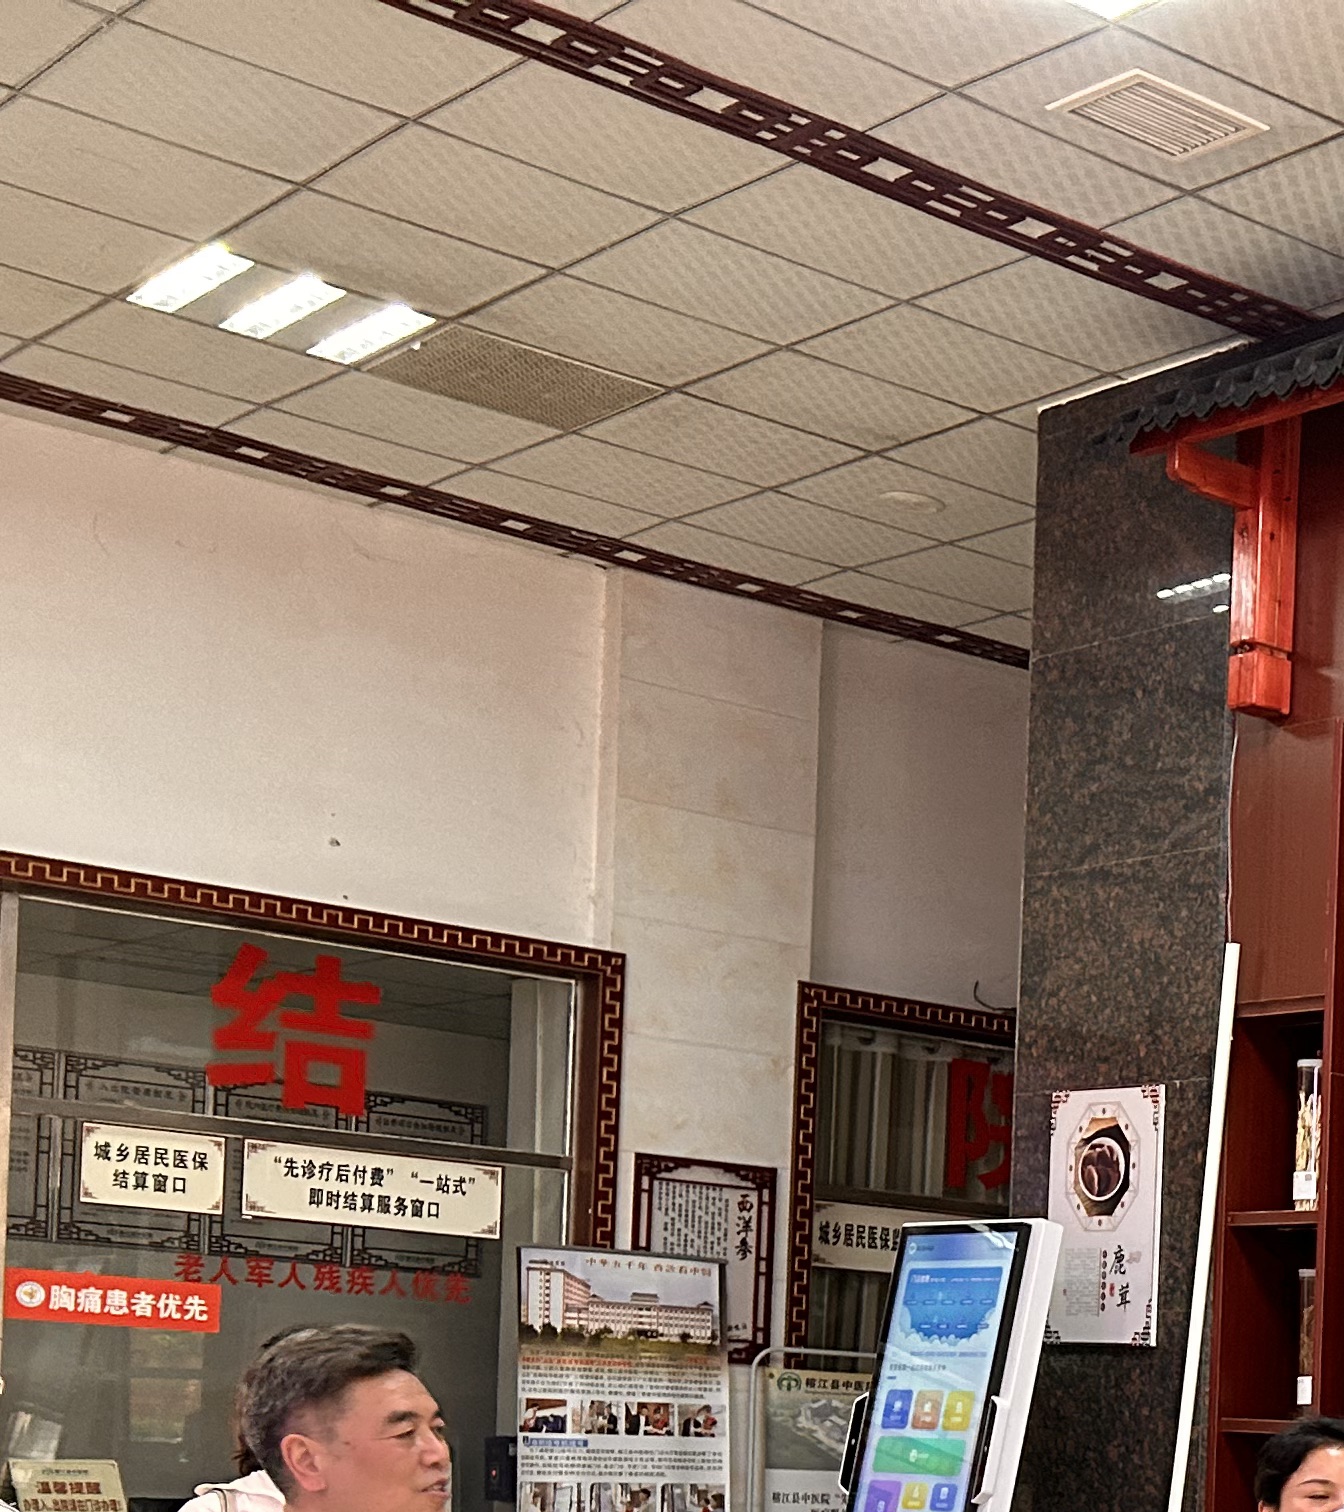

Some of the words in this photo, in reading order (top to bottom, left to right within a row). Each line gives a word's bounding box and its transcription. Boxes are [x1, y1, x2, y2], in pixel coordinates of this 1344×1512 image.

[207, 943, 381, 1117] 结
[94, 1142, 209, 1171] 城乡居民医保
[274, 1157, 394, 1187] “先诊疗后付费”
[113, 1169, 187, 1194] 结算窗口
[308, 1188, 441, 1218] 即时结算服务窗口
[735, 1194, 754, 1260] 西洋参
[174, 1253, 471, 1303] 老人军人残疾人优先
[48, 1285, 209, 1321] 胸痛患者优先
